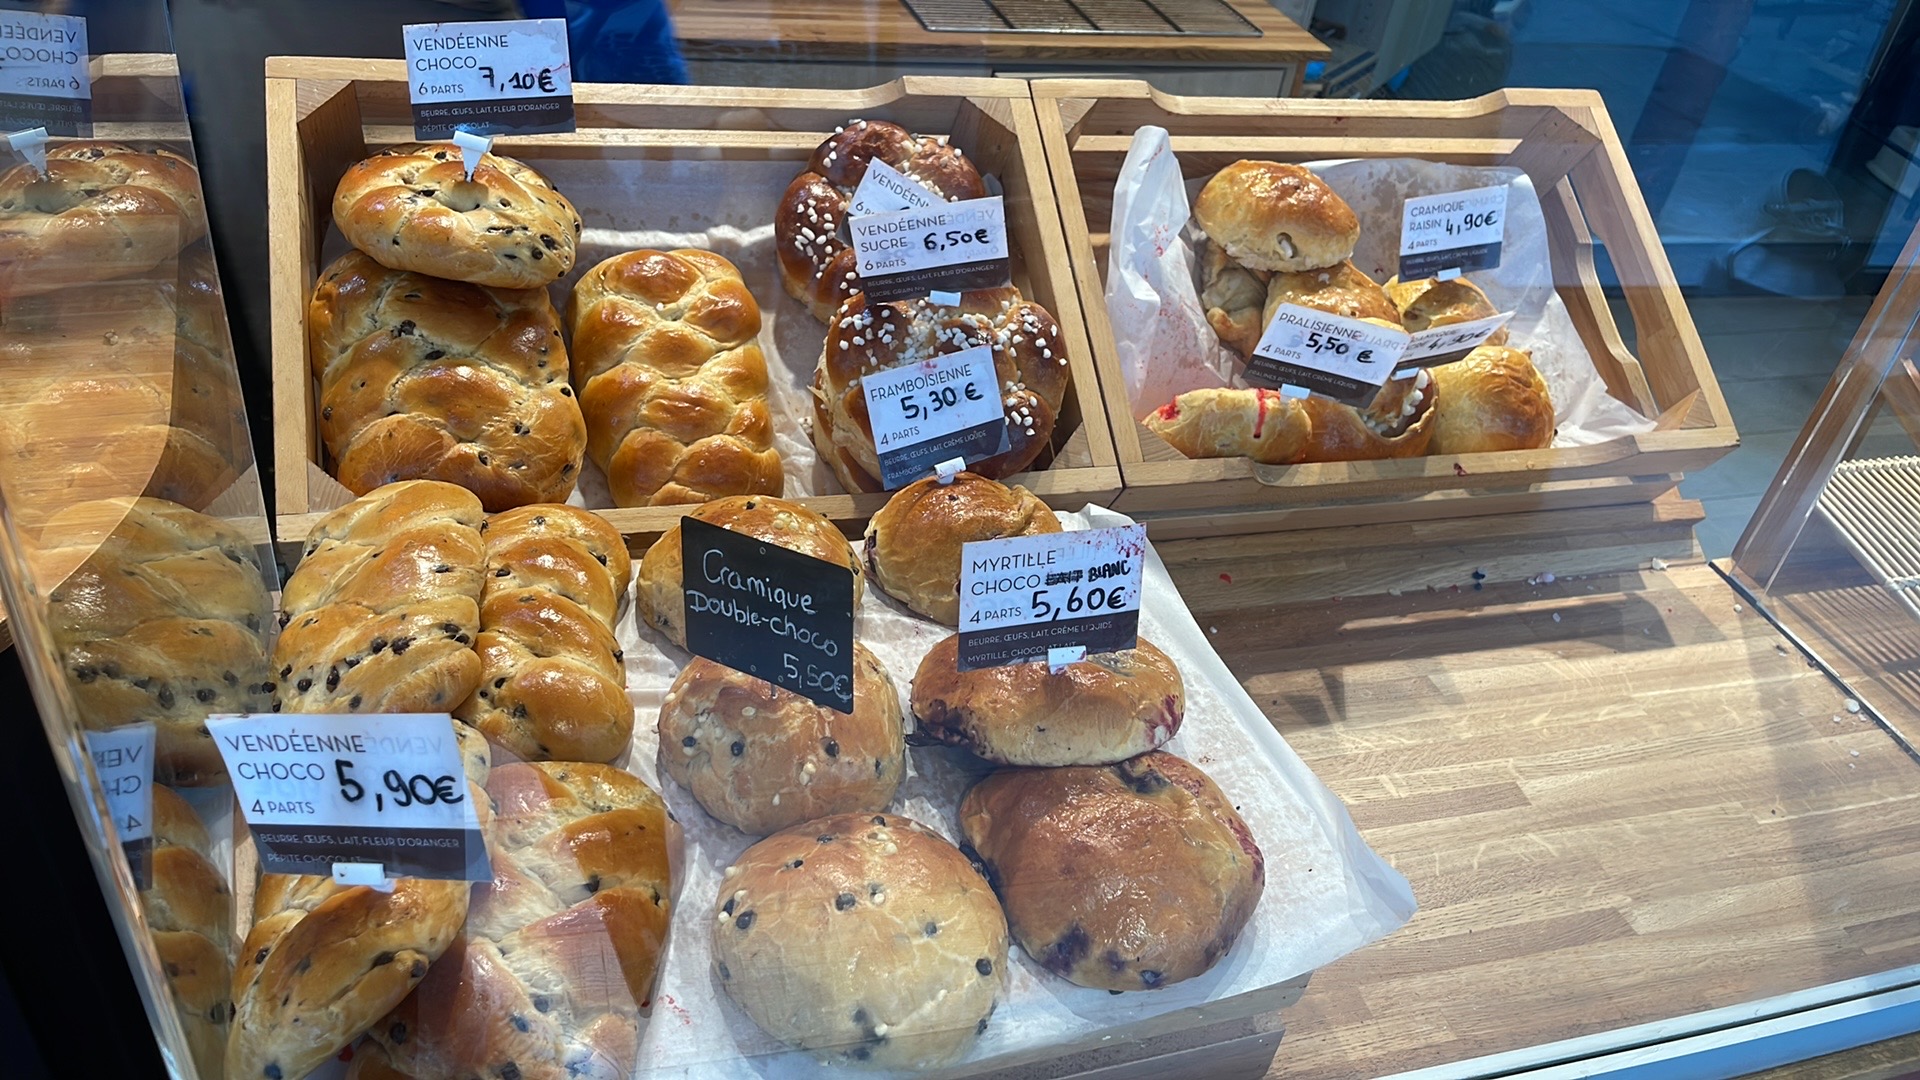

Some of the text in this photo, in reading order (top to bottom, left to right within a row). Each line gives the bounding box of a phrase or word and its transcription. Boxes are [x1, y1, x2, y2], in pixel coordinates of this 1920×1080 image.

[413, 32, 509, 51] VENDÉENNE
[416, 56, 477, 72] CHOCO
[418, 82, 464, 95] 6 PARTS
[479, 66, 557, 92] 7,10€
[493, 105, 516, 114] FLEUR
[518, 103, 560, 113] D'ORANGER
[872, 169, 929, 208] VENDÉEN
[855, 201, 864, 211] 6
[1411, 201, 1464, 217] CRAMIQUE
[857, 215, 946, 236] VENDÉENNE
[1409, 219, 1441, 231] RAISIN
[1446, 210, 1498, 235] 4,90€
[860, 237, 908, 253] SUCRE
[923, 228, 990, 251] 6,50€
[1408, 239, 1437, 249] 4 PARTS
[864, 258, 906, 271] 6 PARTS
[1279, 312, 1360, 340] PRALISIENNE
[1262, 344, 1301, 360] 4 PARTS
[870, 363, 972, 401] FRAMBOISIENNE
[880, 426, 920, 445] 4 PARTS
[972, 549, 1057, 574] MYRTILLE
[702, 549, 817, 615] Cramique
[971, 574, 1041, 596] CHOCO
[1088, 560, 1131, 582] BLANC
[1031, 586, 1127, 621] 5,60€
[969, 606, 1022, 624] 4 PARTS
[1051, 625, 1079, 636] CRÈME
[224, 728, 366, 753] VENDÉENNE
[238, 762, 325, 781] CHOCO
[335, 759, 464, 812] 5,90€
[251, 799, 315, 815] 4 PARTS
[362, 836, 395, 846] FLEUR
[397, 836, 460, 848] D'ORANGER
